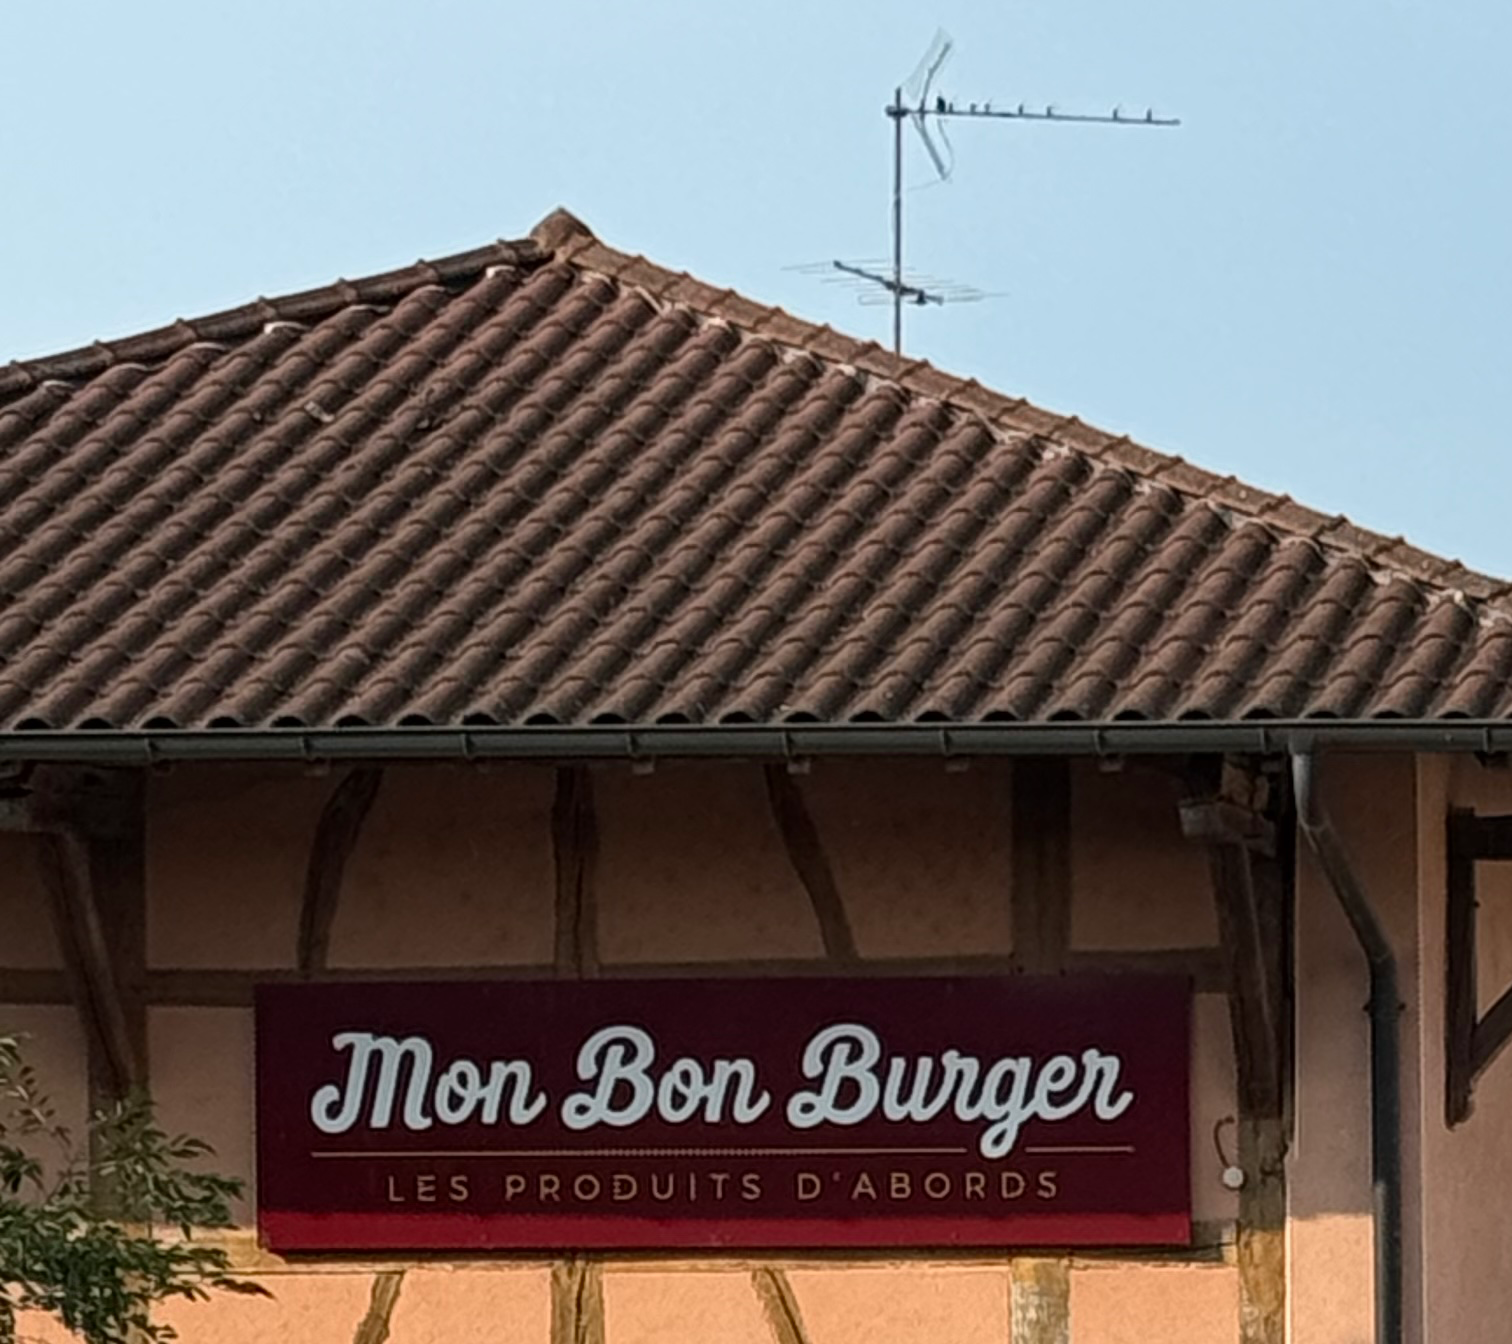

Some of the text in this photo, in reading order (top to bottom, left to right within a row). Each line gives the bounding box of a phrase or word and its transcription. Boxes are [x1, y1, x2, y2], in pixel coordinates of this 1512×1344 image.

[310, 1023, 1134, 1159] Mon Bon Burger
[387, 1170, 1059, 1202] LES PRODUITS D'ABORDS
